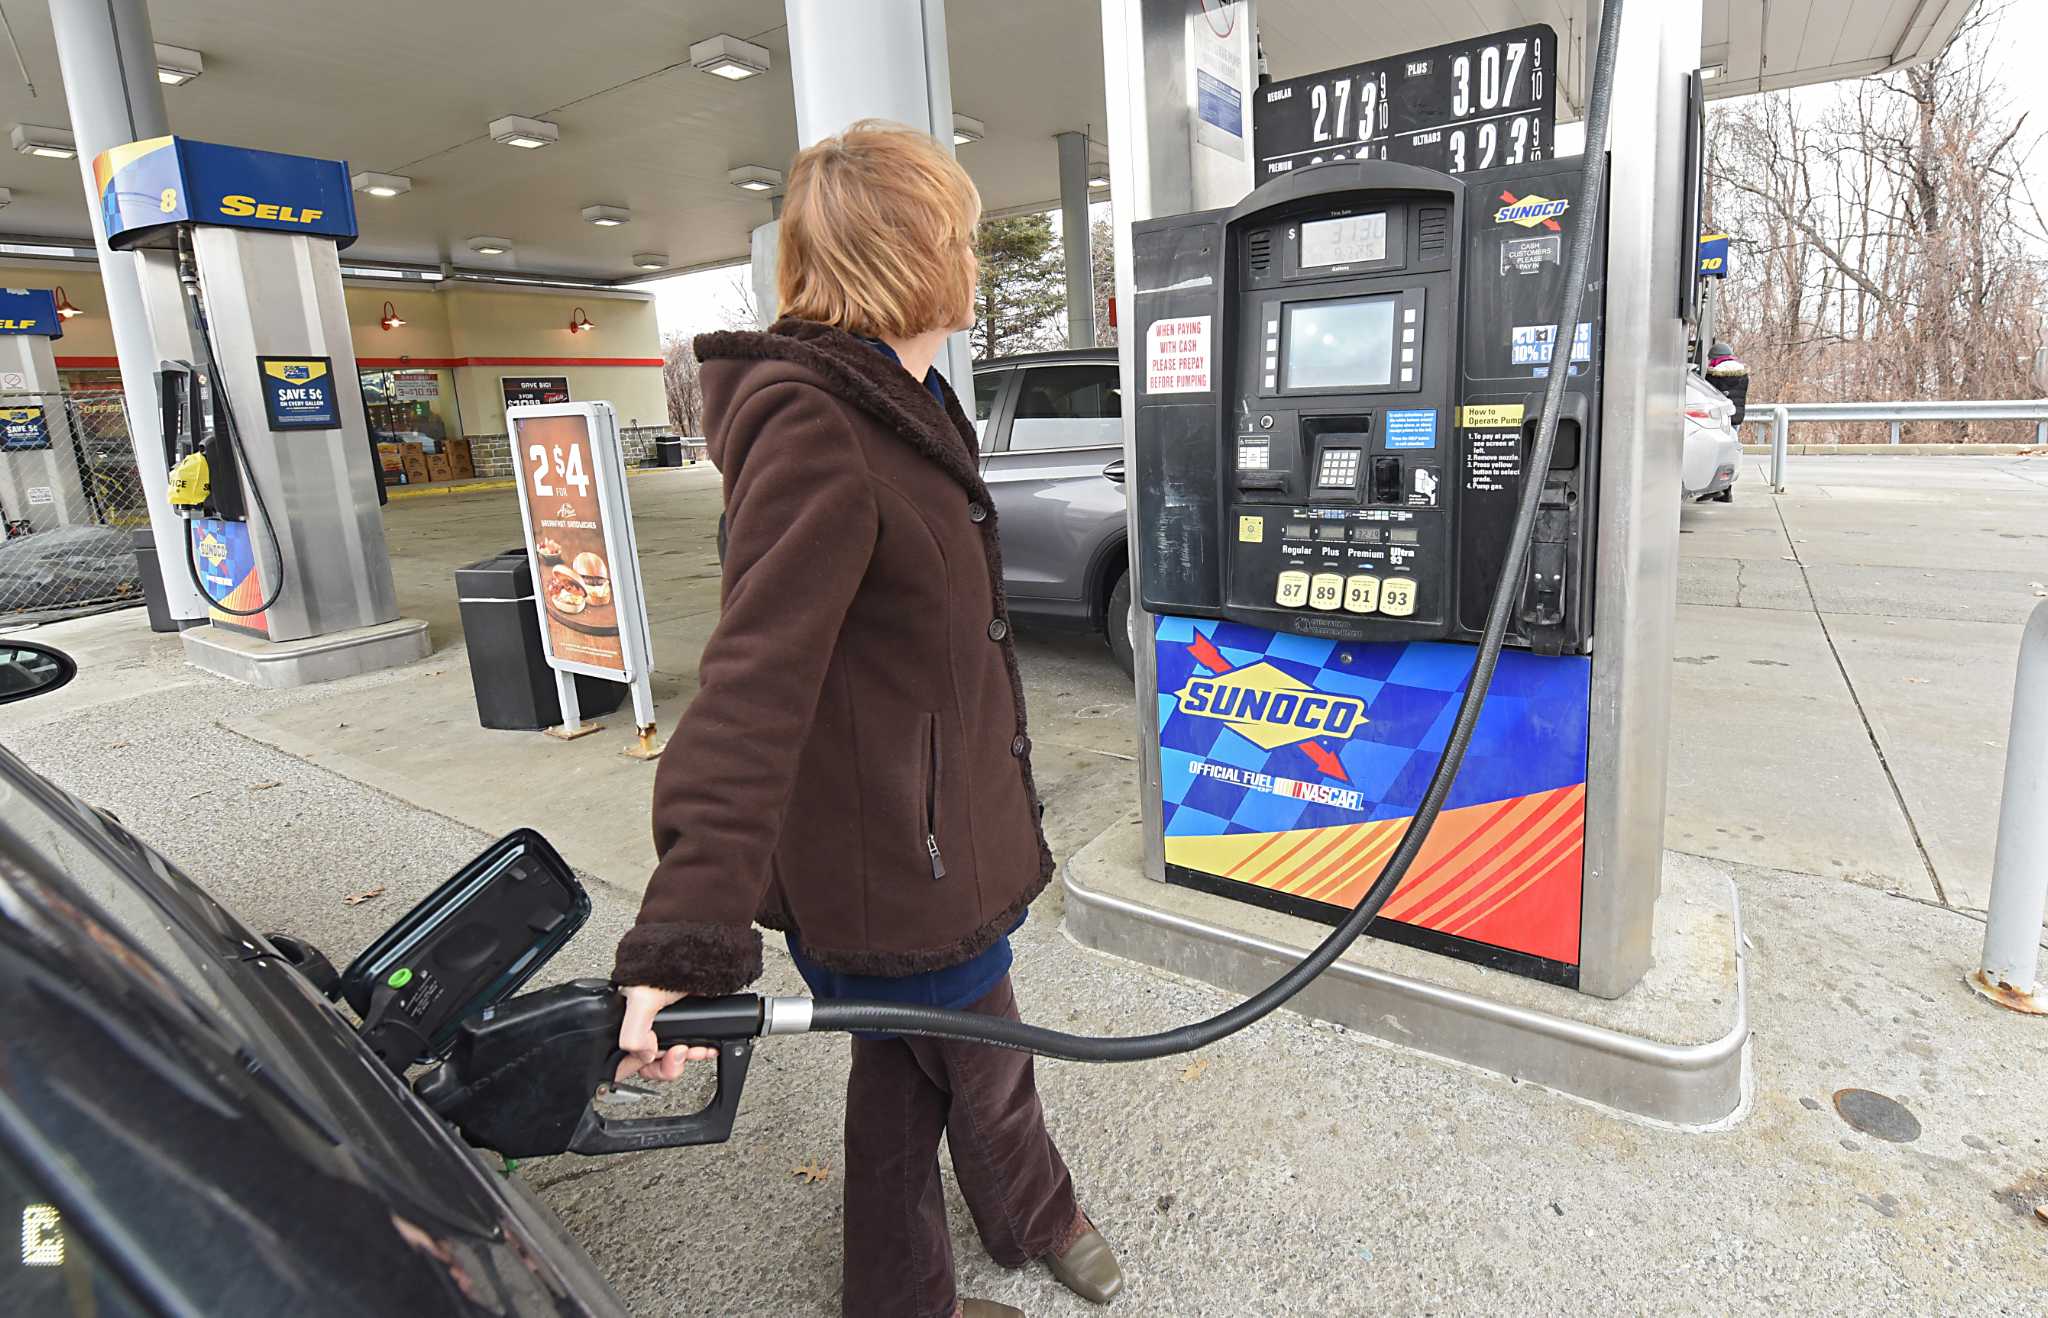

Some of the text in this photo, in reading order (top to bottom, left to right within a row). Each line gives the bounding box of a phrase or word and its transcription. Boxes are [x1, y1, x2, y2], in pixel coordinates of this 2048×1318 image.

[1407, 62, 1428, 76] PLUS
[1453, 42, 1527, 117] 3.07
[1267, 87, 1292, 103] REGULAR
[1311, 79, 1377, 143] 2.73
[159, 188, 177, 214] 8
[219, 194, 324, 224] SELF
[1499, 201, 1567, 221] SUNOCO
[1288, 228, 1296, 240] $
[1701, 257, 1722, 270] 10
[1156, 321, 1201, 337] WHEN PAYING
[1160, 339, 1197, 354] WITH CASH
[1152, 356, 1204, 371] PLEASE PREPAY
[1150, 374, 1206, 388] BEFORE PUMPING
[278, 388, 323, 401] SAVE 5¢
[1468, 416, 1522, 426] Operate Pump
[529, 444, 553, 497] 2
[1491, 461, 1512, 469] yellow
[1473, 482, 1490, 490] Pump
[1282, 545, 1385, 559] Regular Plus Premium
[1390, 547, 1415, 557] Ultra
[1390, 557, 1402, 565] 93
[1283, 584, 1302, 597] 87
[1316, 586, 1336, 600] 89
[1351, 588, 1371, 603] 91
[1387, 591, 1408, 605] 93
[1184, 681, 1358, 734] SUNOCO
[1189, 760, 1274, 789] OFFICIAL FUEL
[1299, 781, 1360, 810] NASCAR
